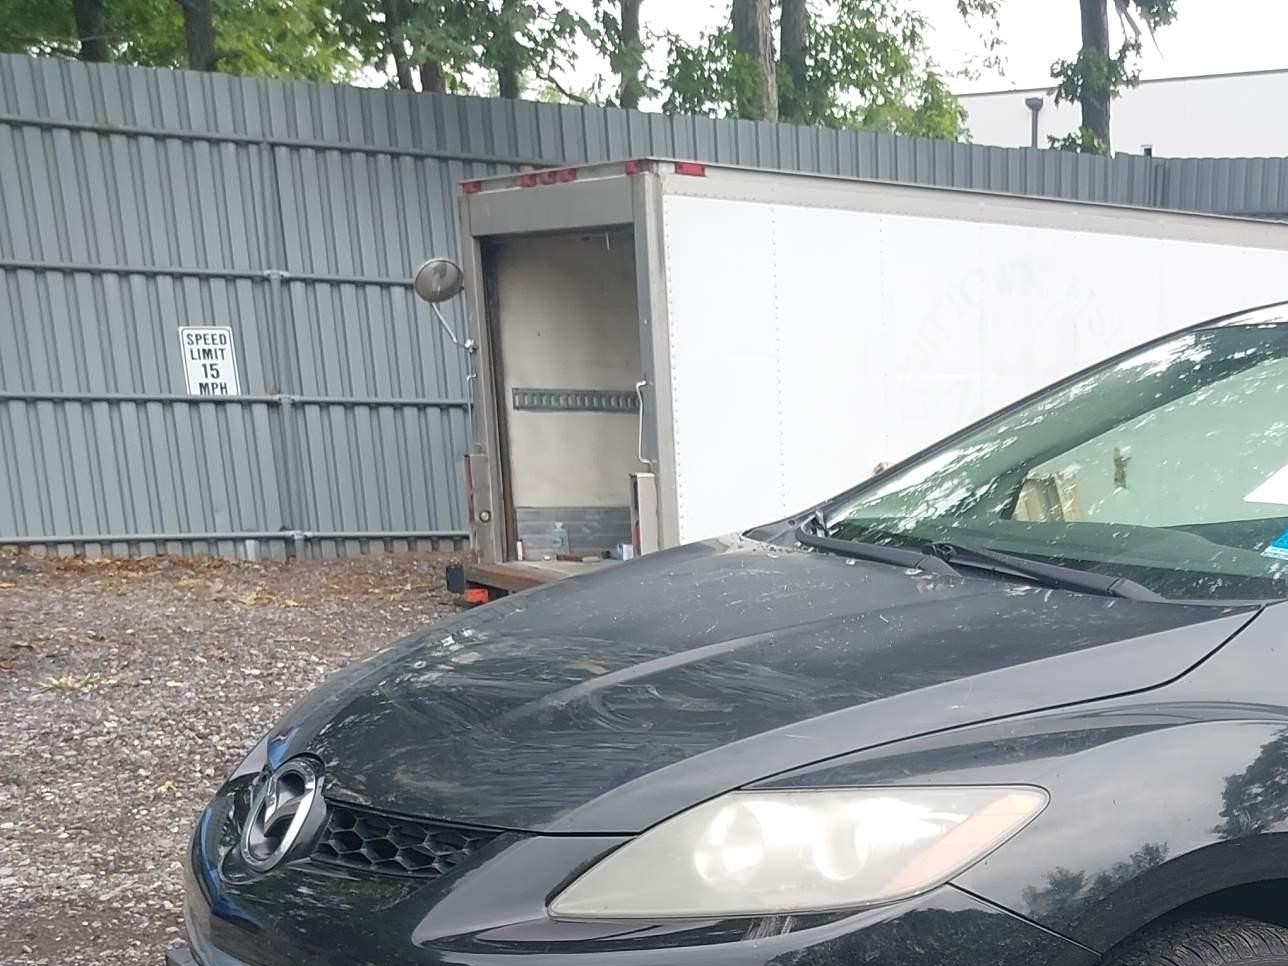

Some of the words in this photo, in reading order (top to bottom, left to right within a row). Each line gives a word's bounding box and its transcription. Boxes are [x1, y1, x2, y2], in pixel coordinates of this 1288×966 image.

[186, 333, 227, 346] SPEED
[190, 347, 226, 361] LIMIT
[201, 363, 221, 380] 15
[199, 381, 229, 396] MPH
